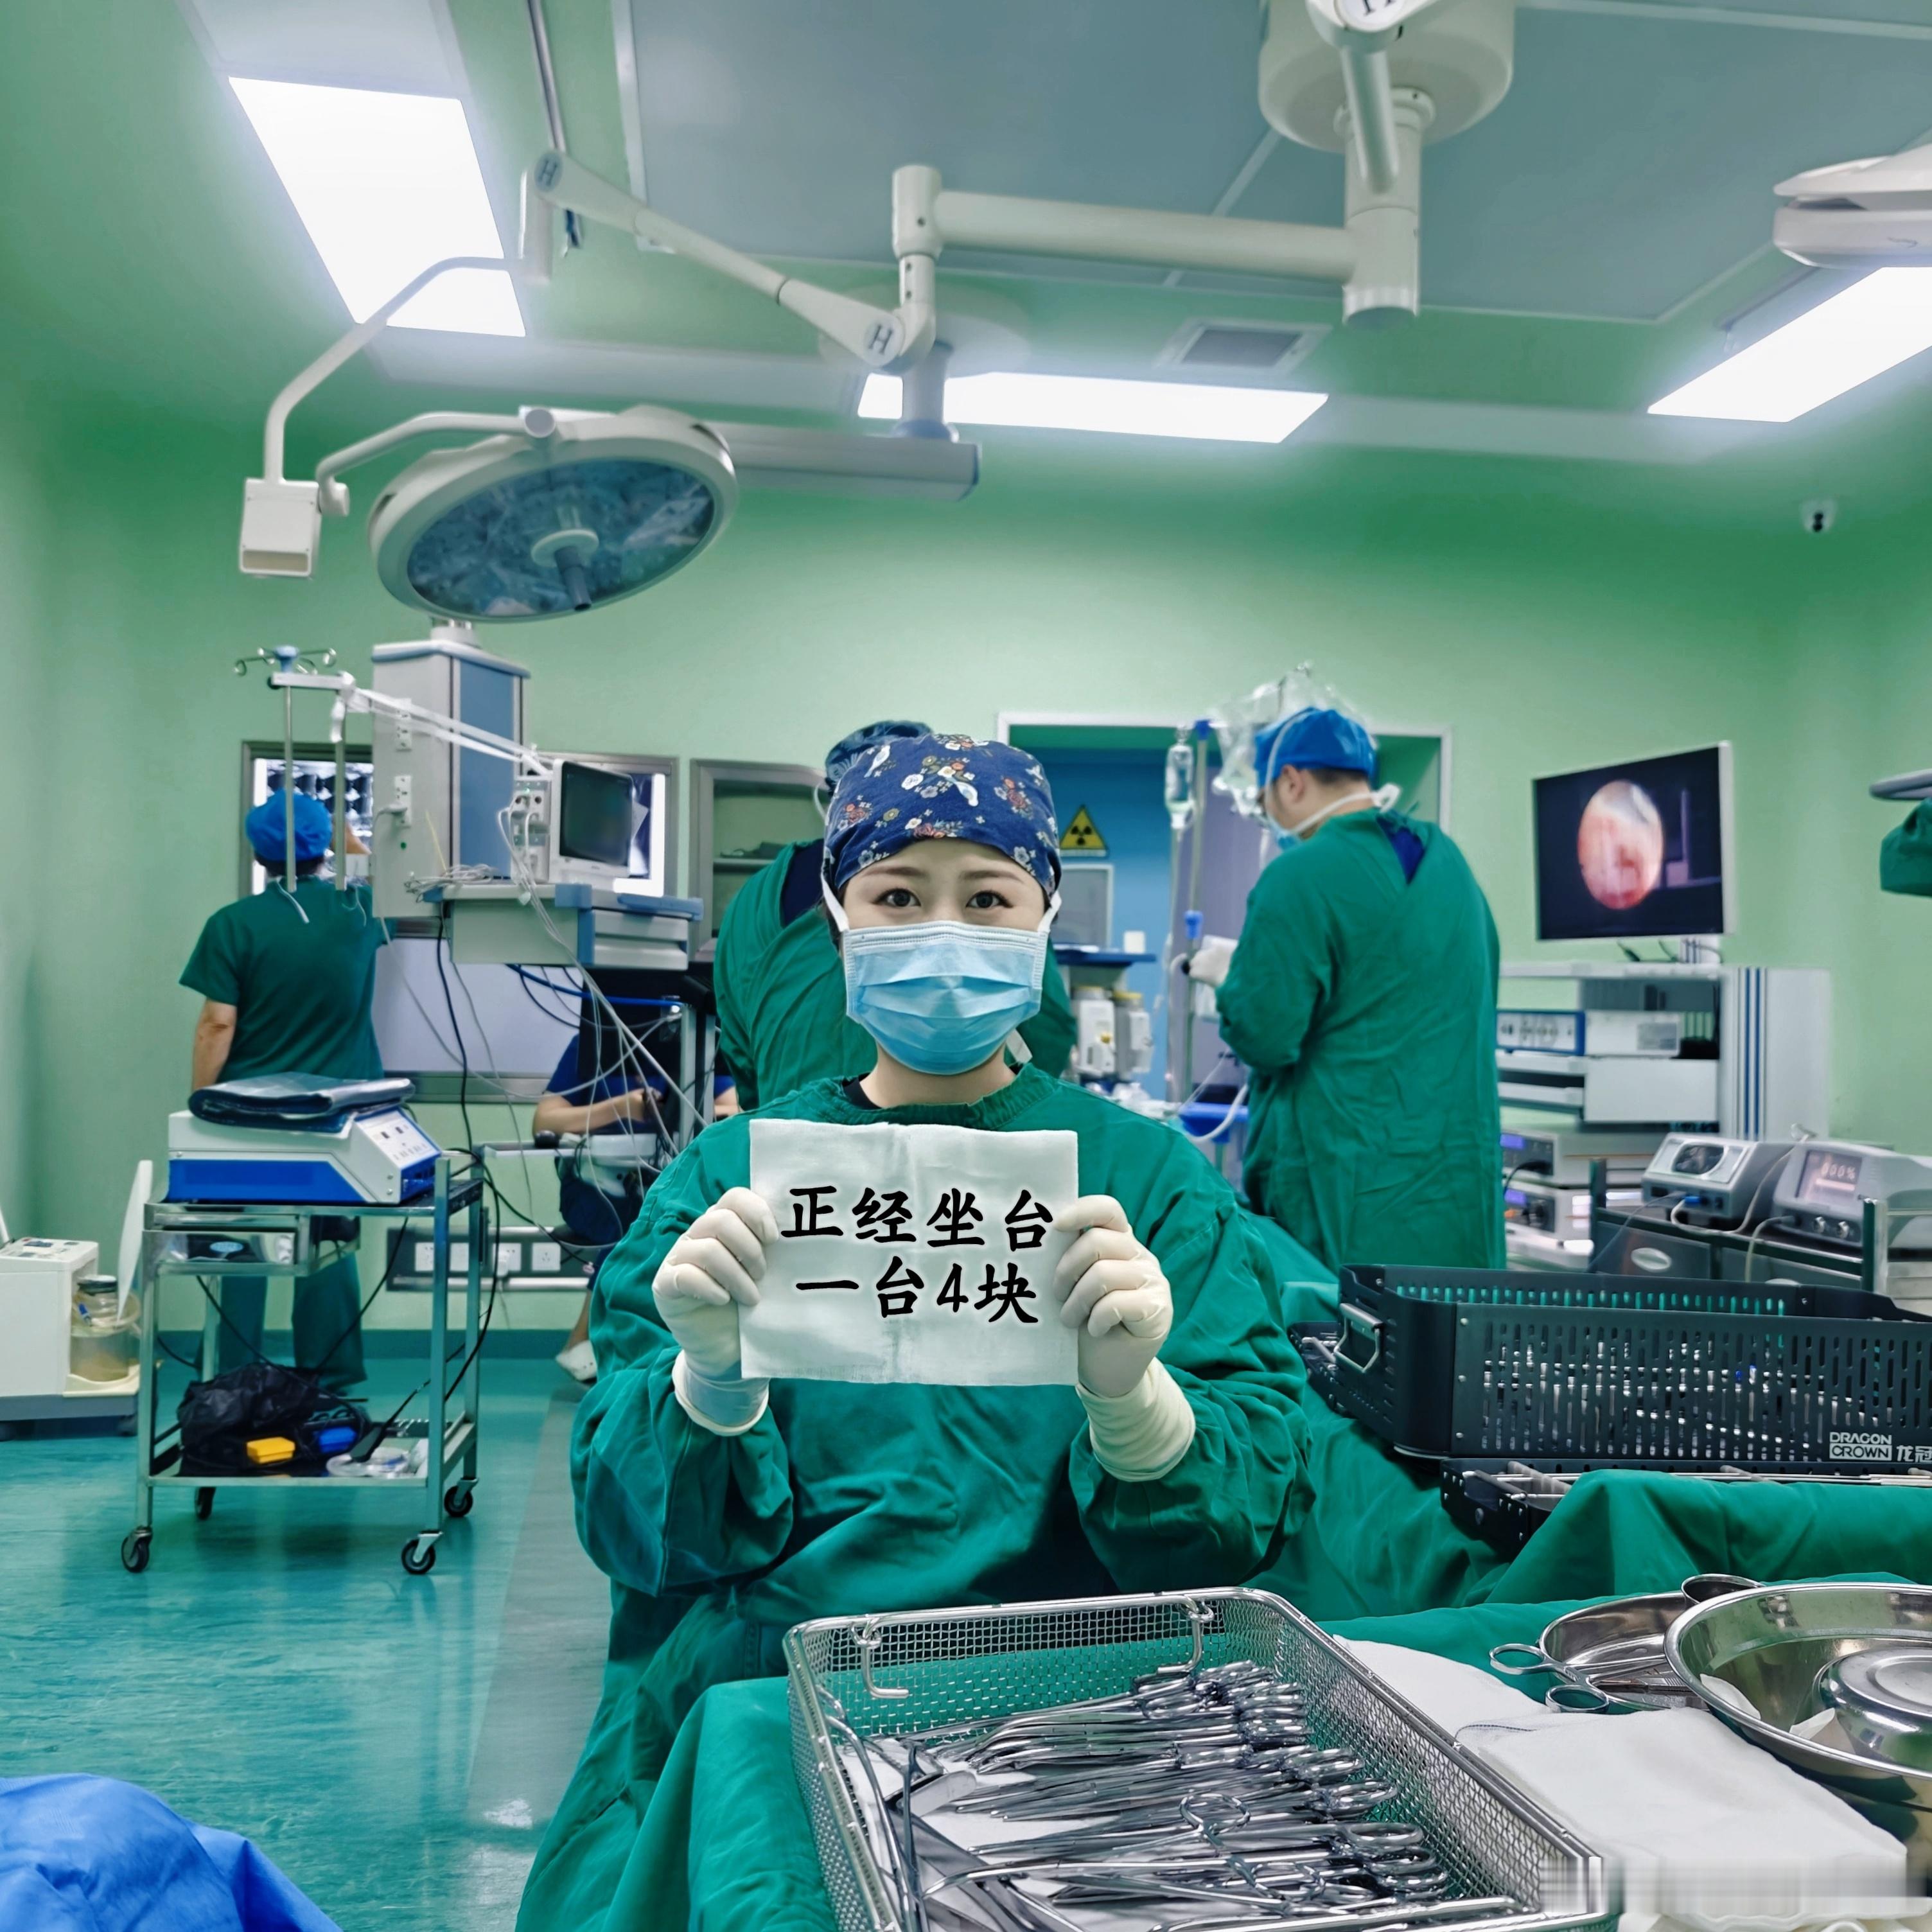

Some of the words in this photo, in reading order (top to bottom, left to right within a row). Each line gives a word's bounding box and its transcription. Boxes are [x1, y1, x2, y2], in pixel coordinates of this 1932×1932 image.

[868, 324, 893, 355] H
[1830, 1432, 1892, 1445] DRAGON
[1831, 1445, 1888, 1458] CROWN
